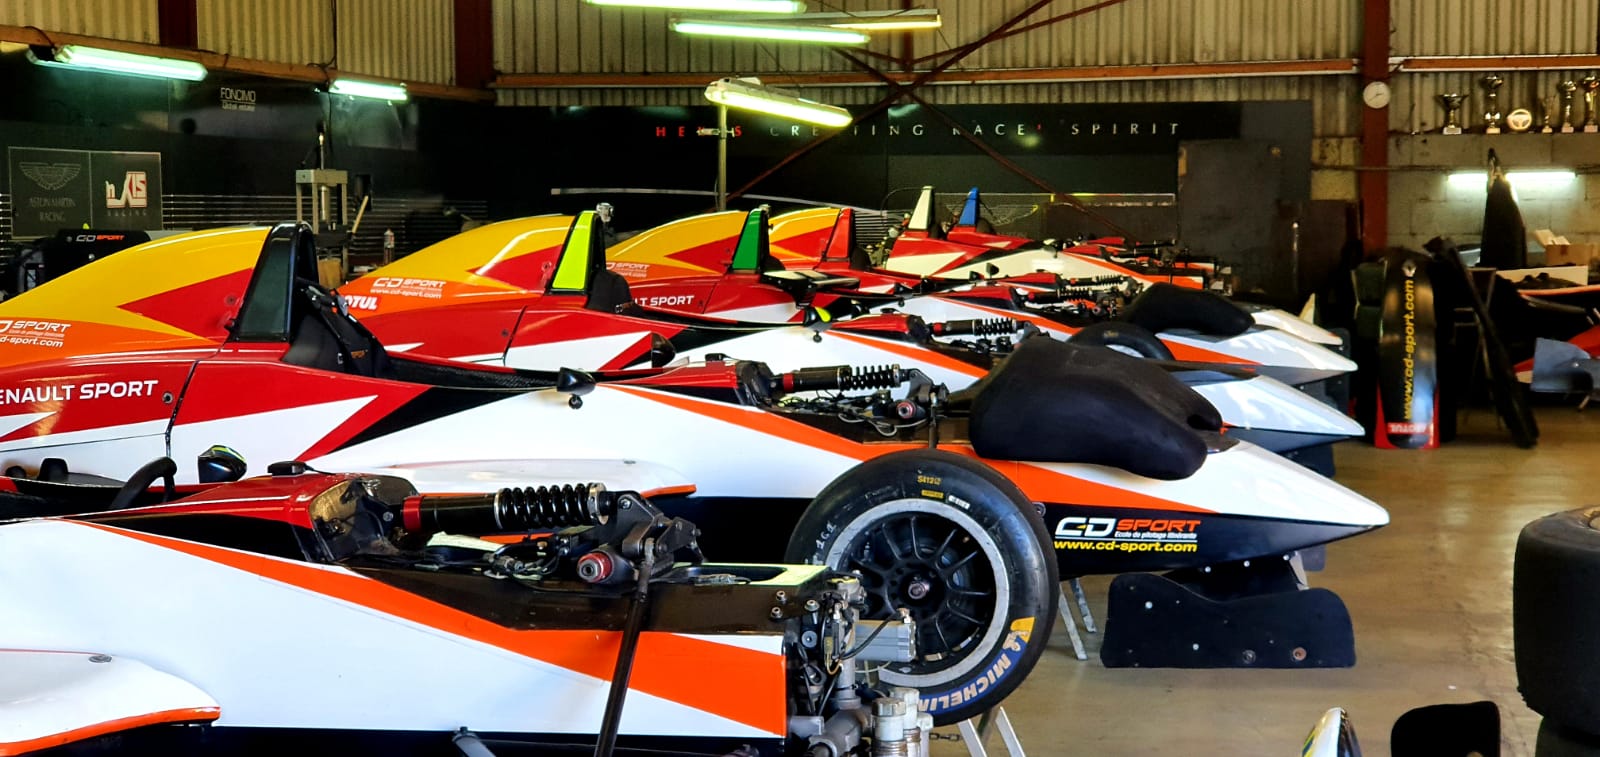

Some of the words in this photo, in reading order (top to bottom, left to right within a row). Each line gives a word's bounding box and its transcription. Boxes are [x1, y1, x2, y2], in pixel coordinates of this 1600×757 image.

[220, 87, 256, 102] FONCIMO
[769, 125, 925, 137] CRETING
[1071, 123, 1179, 135] SPIRIT
[615, 262, 650, 270] SPORT
[403, 278, 447, 288] SPORT
[344, 294, 378, 310] OTUL
[649, 295, 695, 307] SPORT
[12, 320, 72, 333] SPORT
[0, 335, 64, 348] d-sport.com
[1403, 279, 1416, 420] www.cd-sport.com
[79, 380, 159, 400] SPORT
[1116, 518, 1201, 532] SPORT
[1053, 540, 1198, 553] www.cd-sport.com
[917, 653, 1012, 711] MICHELIN
